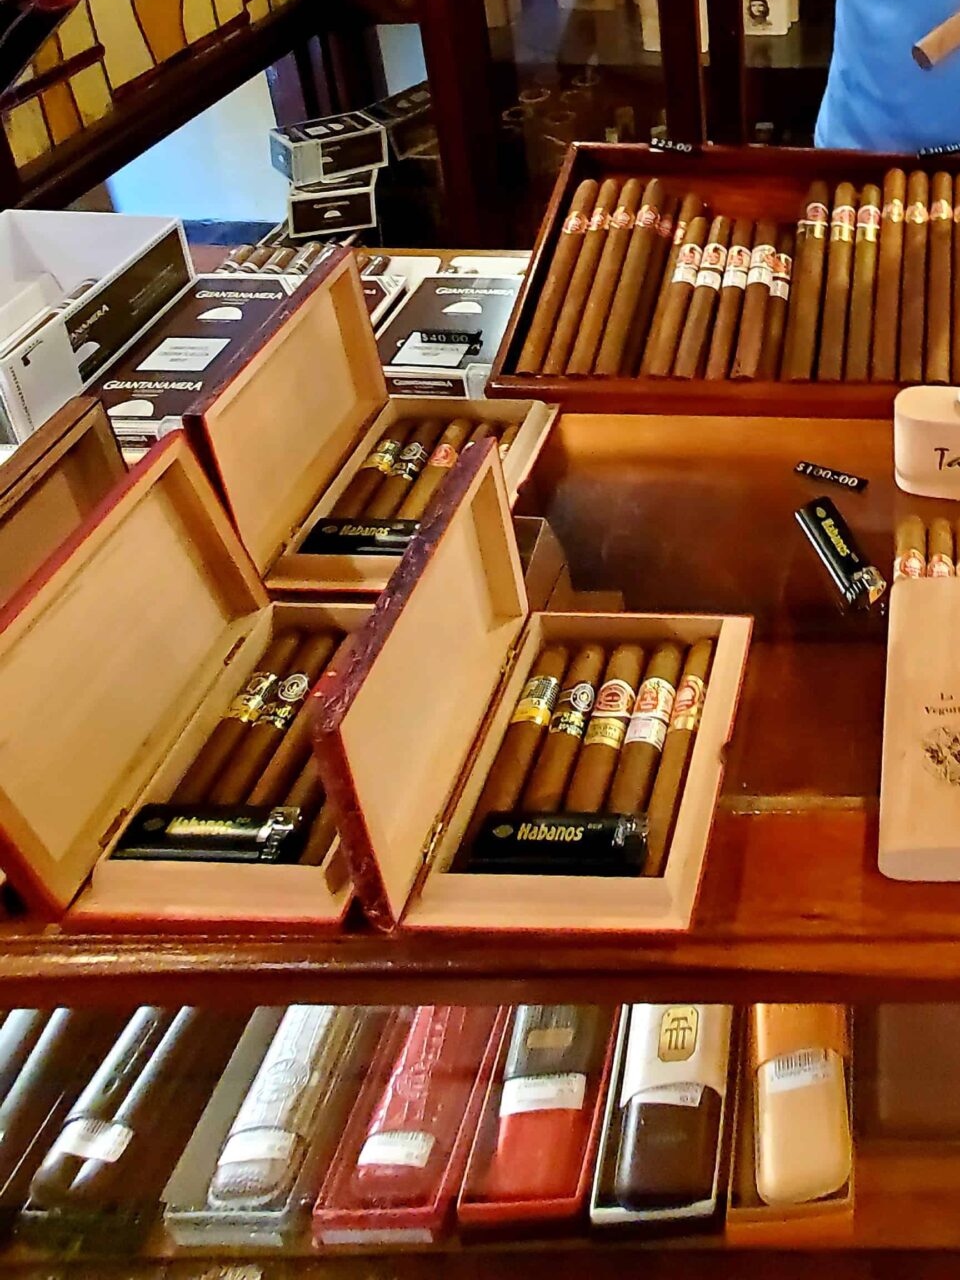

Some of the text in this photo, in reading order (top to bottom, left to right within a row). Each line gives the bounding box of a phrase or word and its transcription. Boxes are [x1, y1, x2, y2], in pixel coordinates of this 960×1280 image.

[195, 289, 284, 301] GUANTANAMERA
[435, 286, 515, 297] GUANTANAMERA
[103, 380, 203, 392] GUANTANAMERA
[339, 524, 390, 537] Habanos
[517, 822, 584, 842] Habanos
